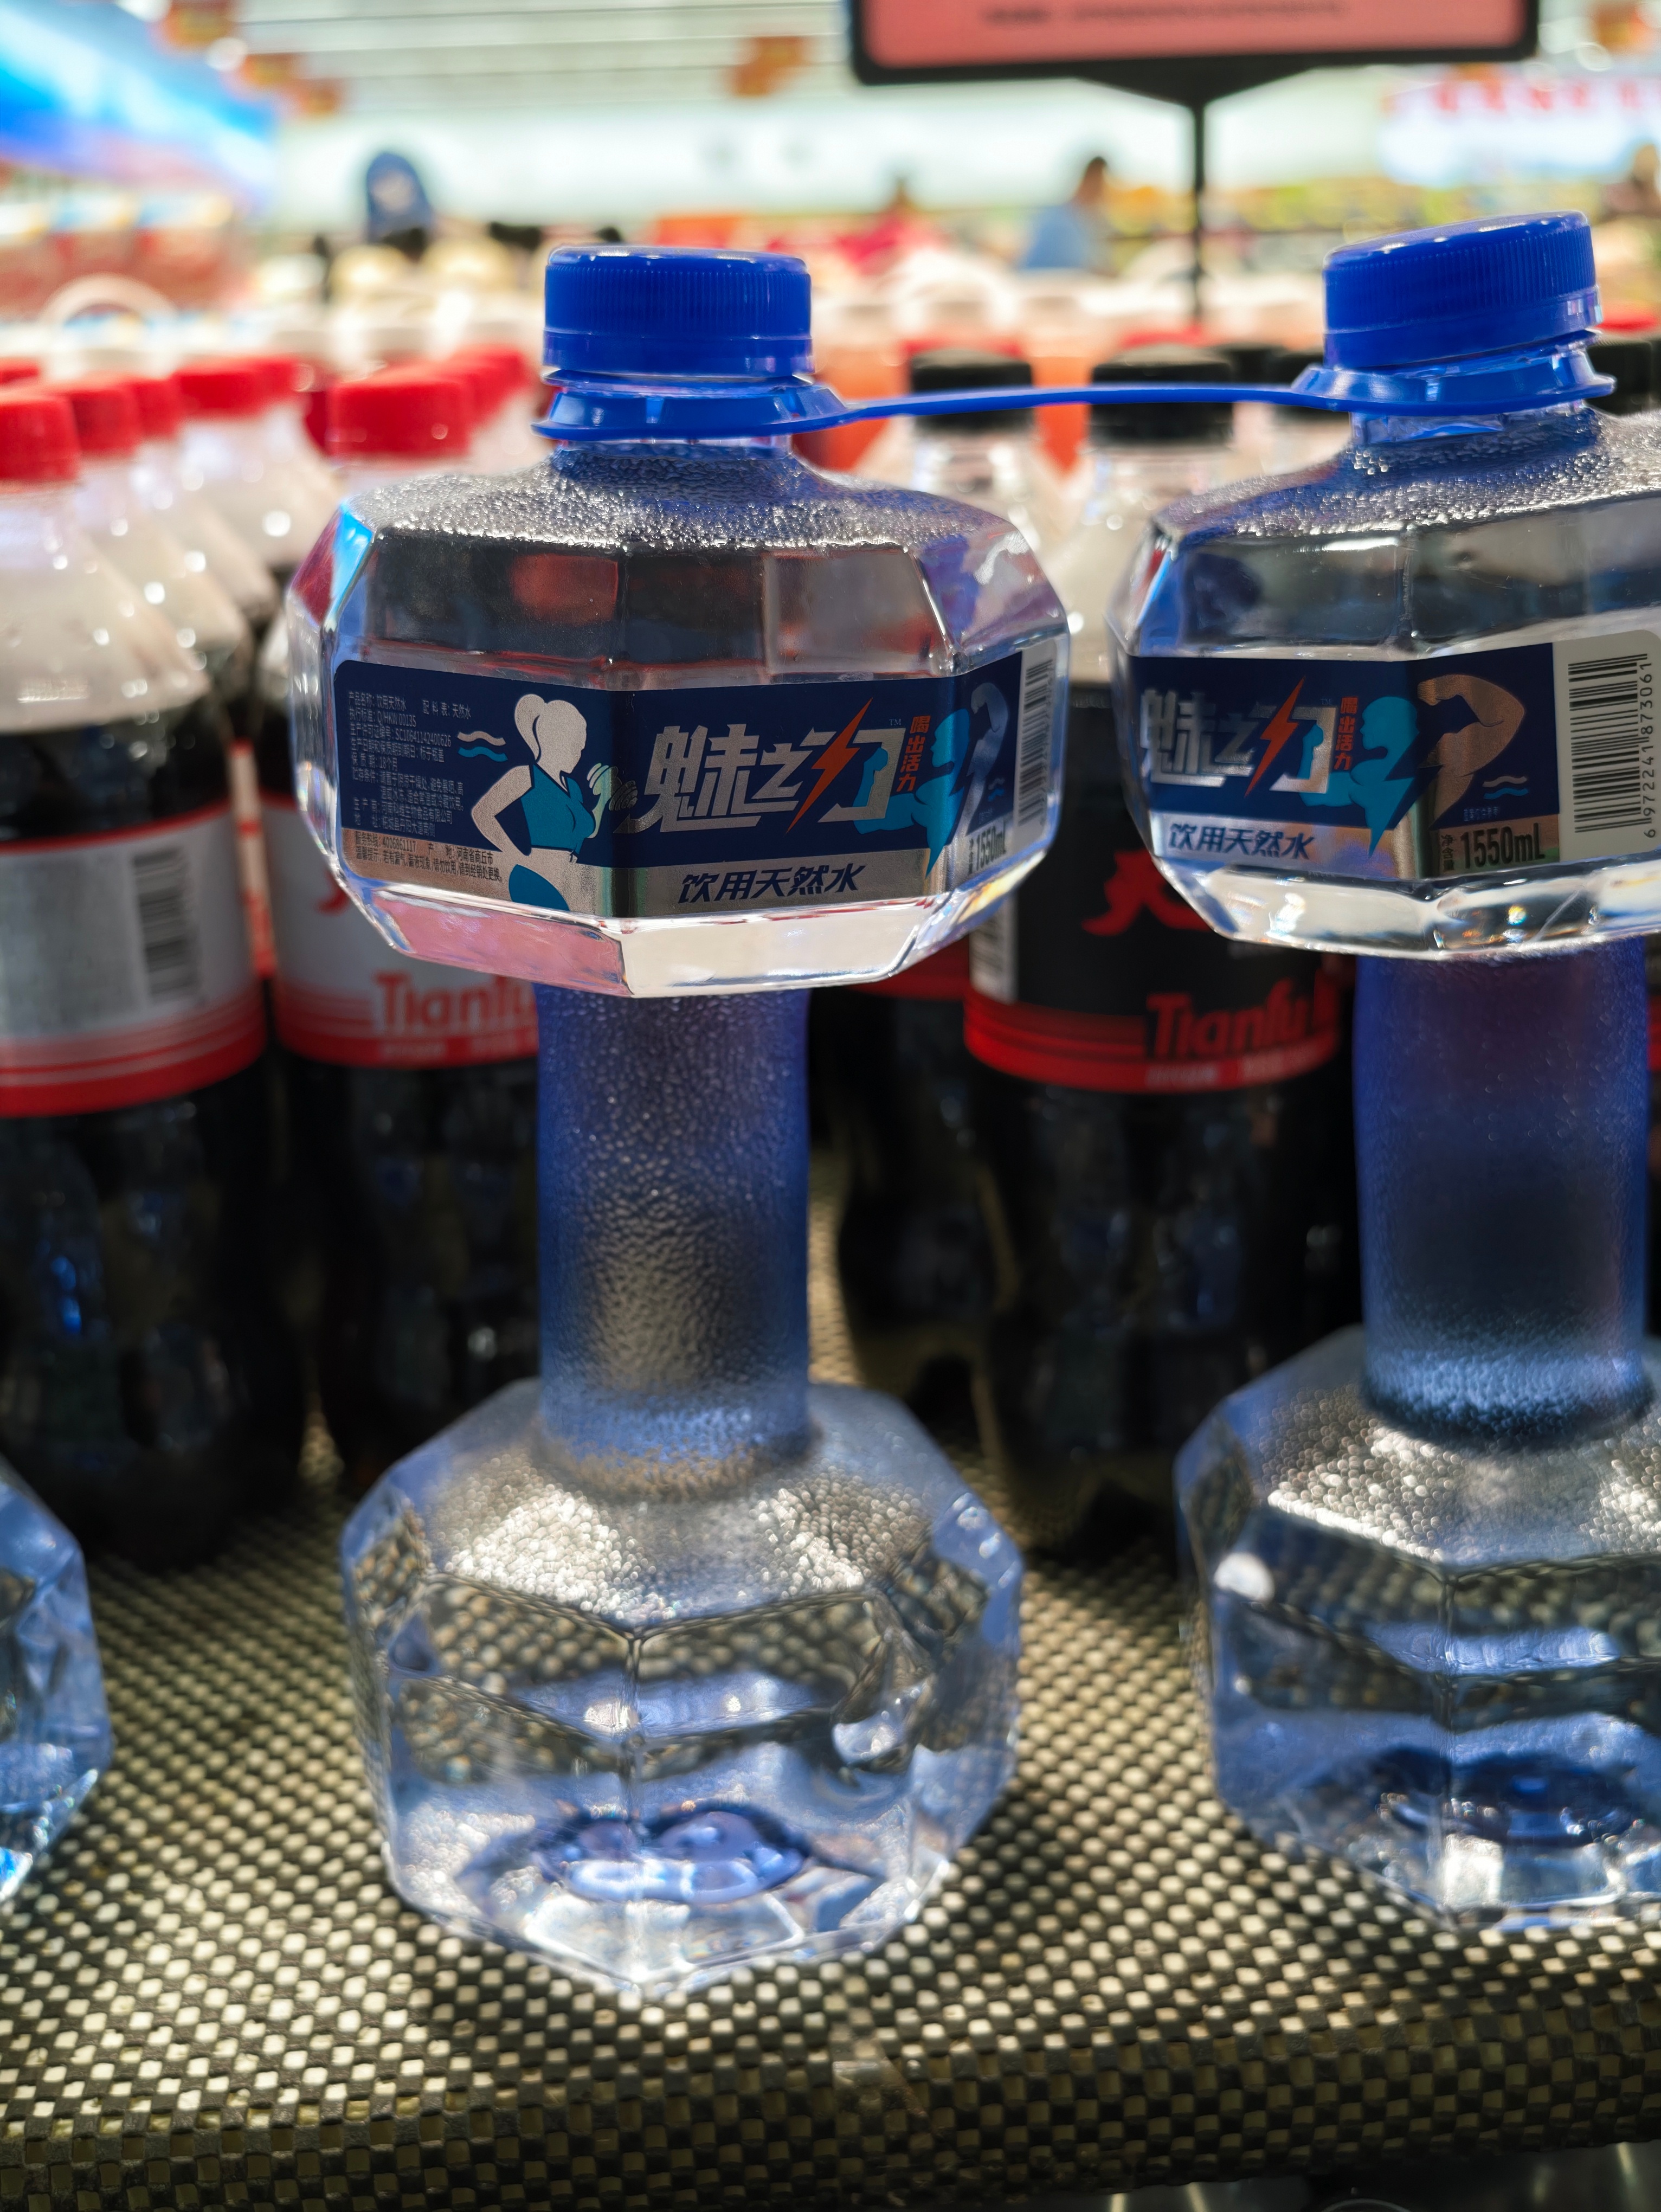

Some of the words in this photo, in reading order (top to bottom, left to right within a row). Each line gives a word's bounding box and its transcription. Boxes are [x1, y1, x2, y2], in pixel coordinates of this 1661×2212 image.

[896, 715, 931, 792] 喝出活力
[1169, 823, 1317, 860] 饮用天然水
[1460, 822, 1545, 869] 1550mL
[678, 865, 867, 904] 饮用天然水
